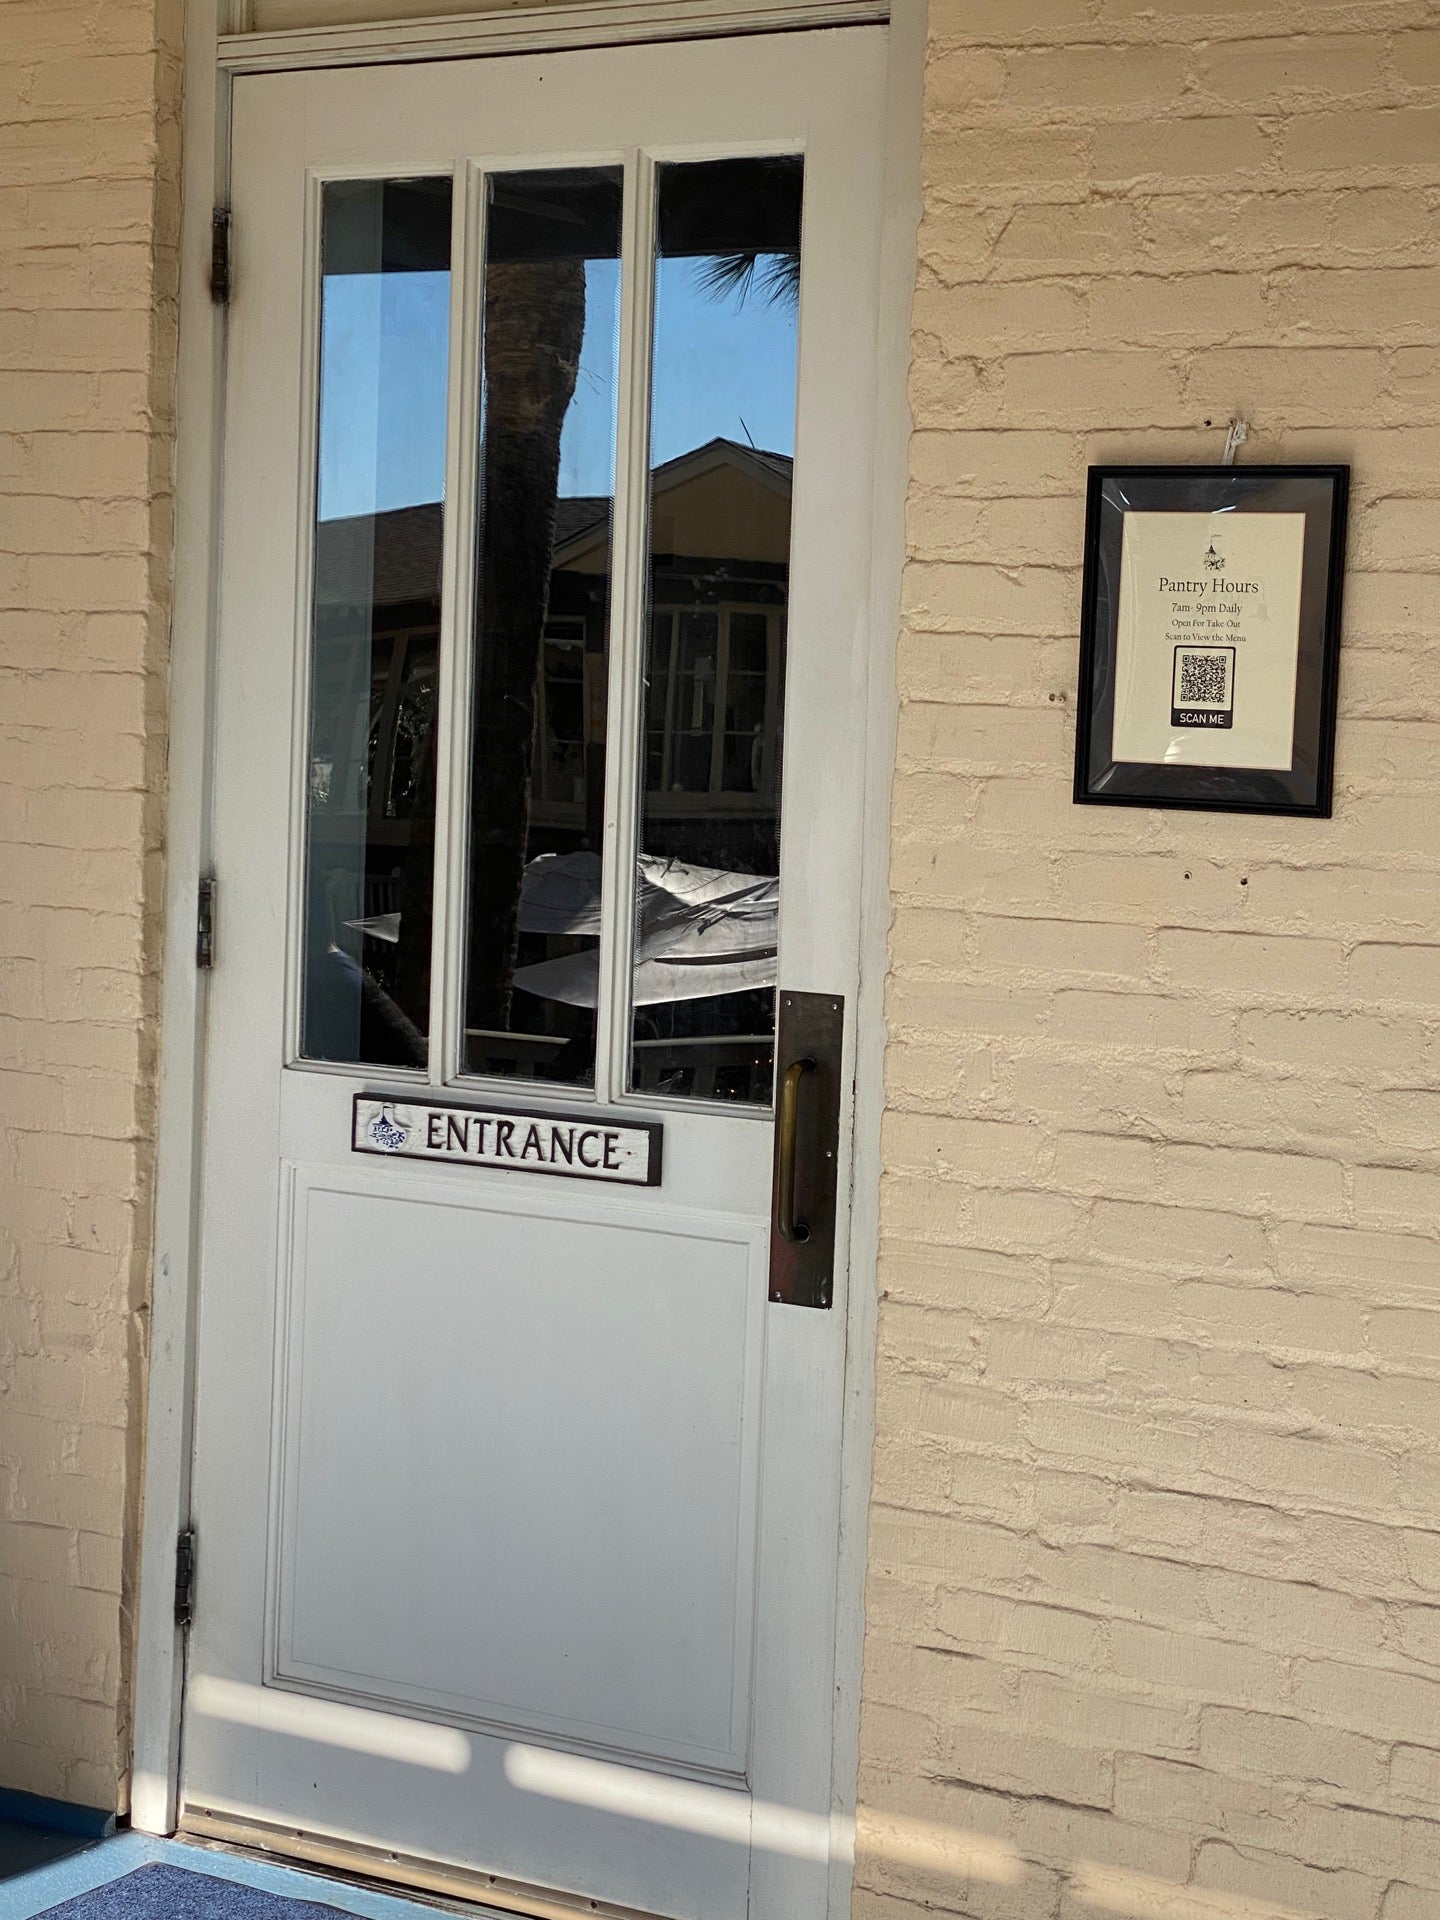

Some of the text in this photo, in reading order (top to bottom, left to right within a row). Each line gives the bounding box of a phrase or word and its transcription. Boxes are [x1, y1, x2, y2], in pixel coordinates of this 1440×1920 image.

[1158, 577, 1259, 597] Pantry Hours
[1196, 602, 1216, 615] 9pm
[1218, 603, 1243, 616] Daily
[1171, 618, 1191, 628] Open
[1192, 619, 1205, 627] For
[1165, 632, 1247, 642] Scan to View the Menu
[1179, 712, 1225, 724] SCAN ME
[426, 1113, 620, 1170] ENTRANCE
